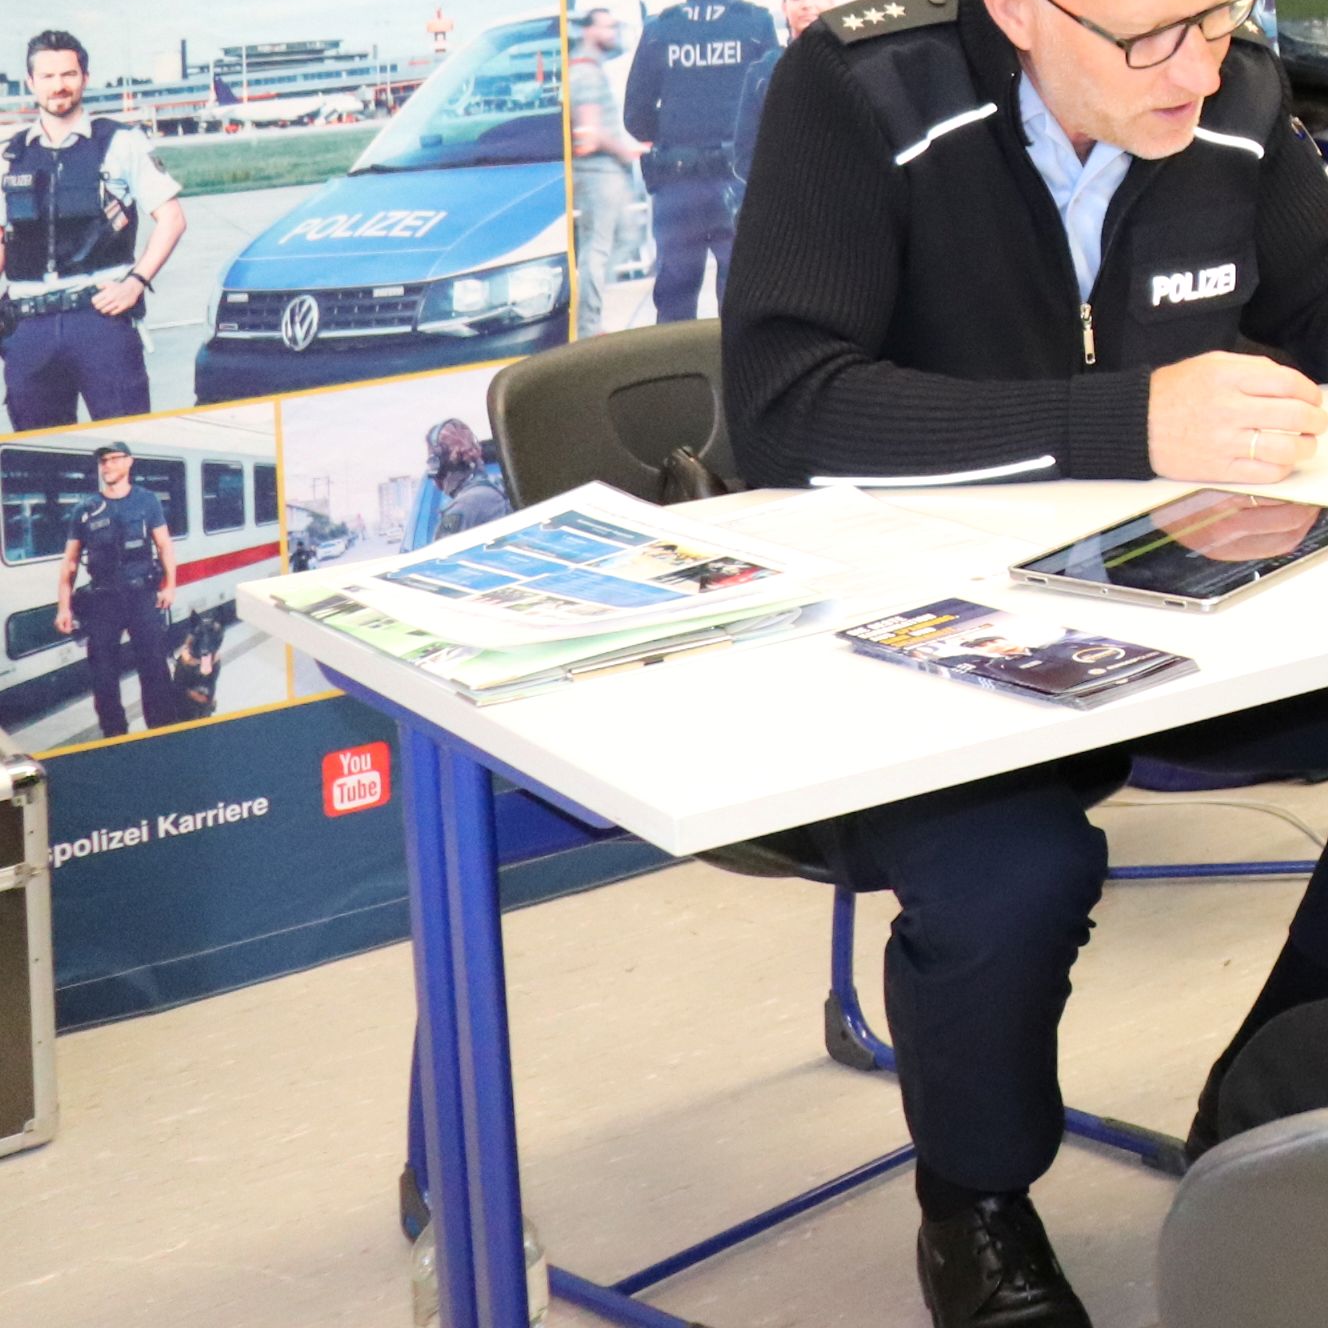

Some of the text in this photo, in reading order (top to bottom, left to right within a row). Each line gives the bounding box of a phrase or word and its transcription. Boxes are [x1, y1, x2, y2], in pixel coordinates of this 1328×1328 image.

[668, 41, 742, 68] POLIZEI
[278, 210, 448, 246] POLIZEI
[1152, 262, 1237, 307] POLIZEI
[339, 751, 372, 776] You
[336, 779, 378, 804] Tube
[157, 796, 269, 839] Karriere
